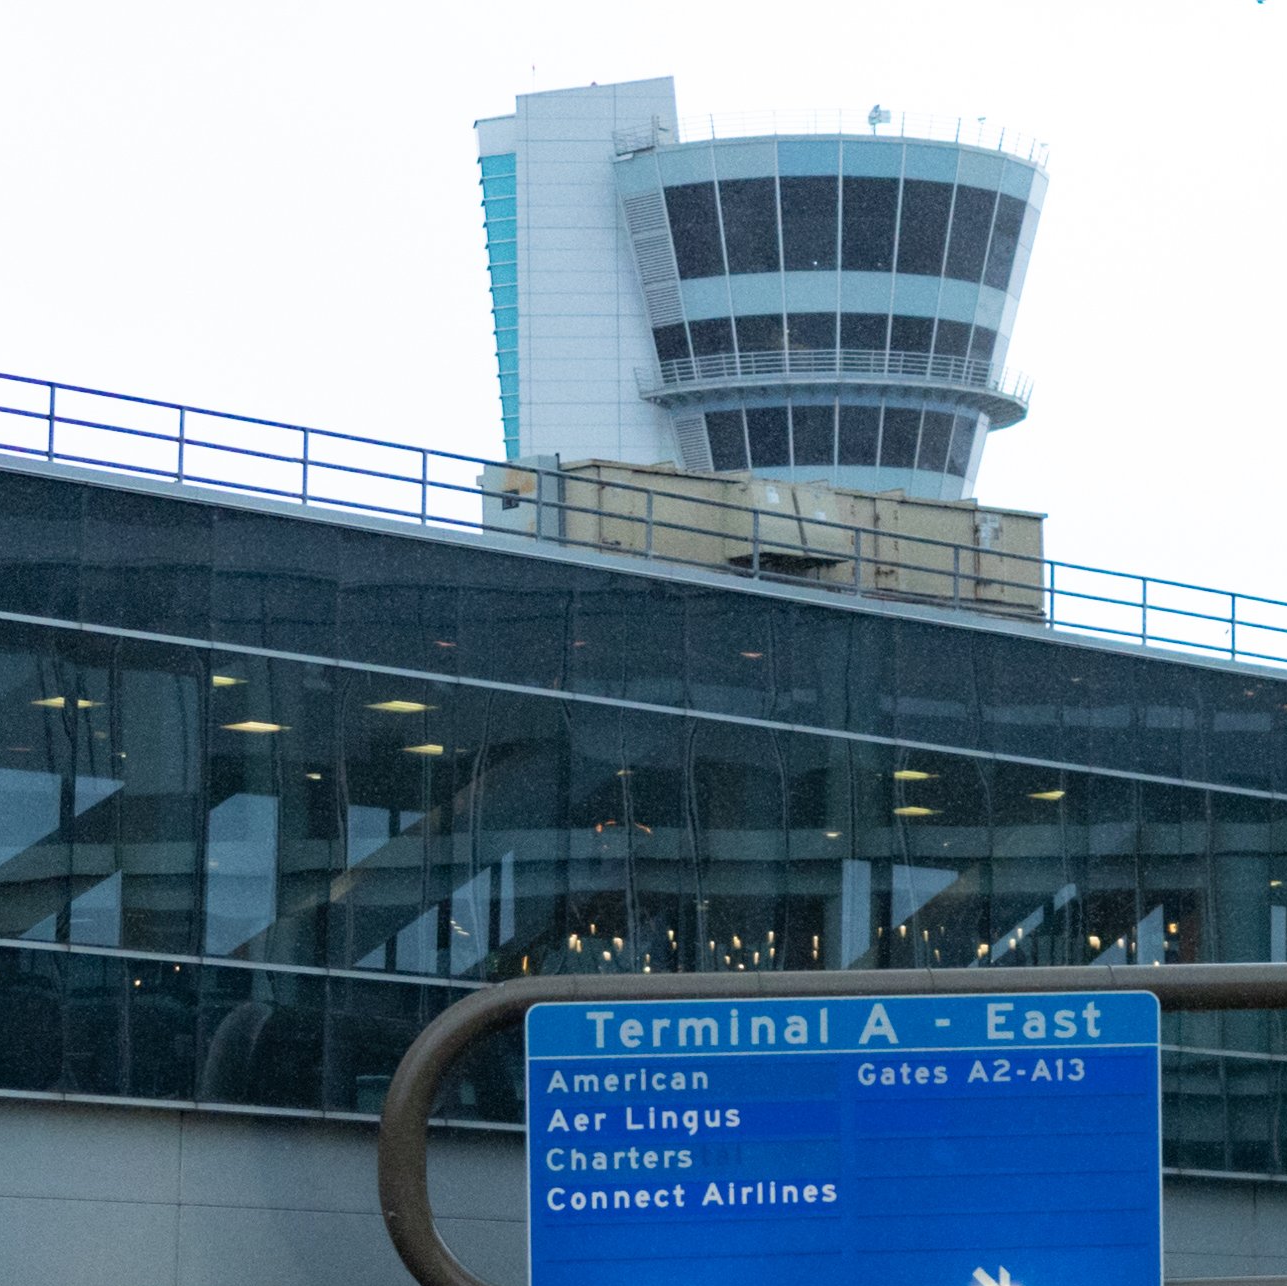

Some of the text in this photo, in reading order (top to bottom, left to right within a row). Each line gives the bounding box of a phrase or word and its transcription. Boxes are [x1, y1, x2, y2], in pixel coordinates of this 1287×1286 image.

[587, 1008, 828, 1048] Terminal
[859, 1003, 898, 1044] A
[987, 1002, 1101, 1040] East
[547, 1069, 708, 1092] American
[857, 1058, 1086, 1086] Gates A2-A13
[548, 1105, 741, 1136] Aer Lingus
[546, 1147, 693, 1171] Charters
[547, 1181, 837, 1211] Connect Airlines
